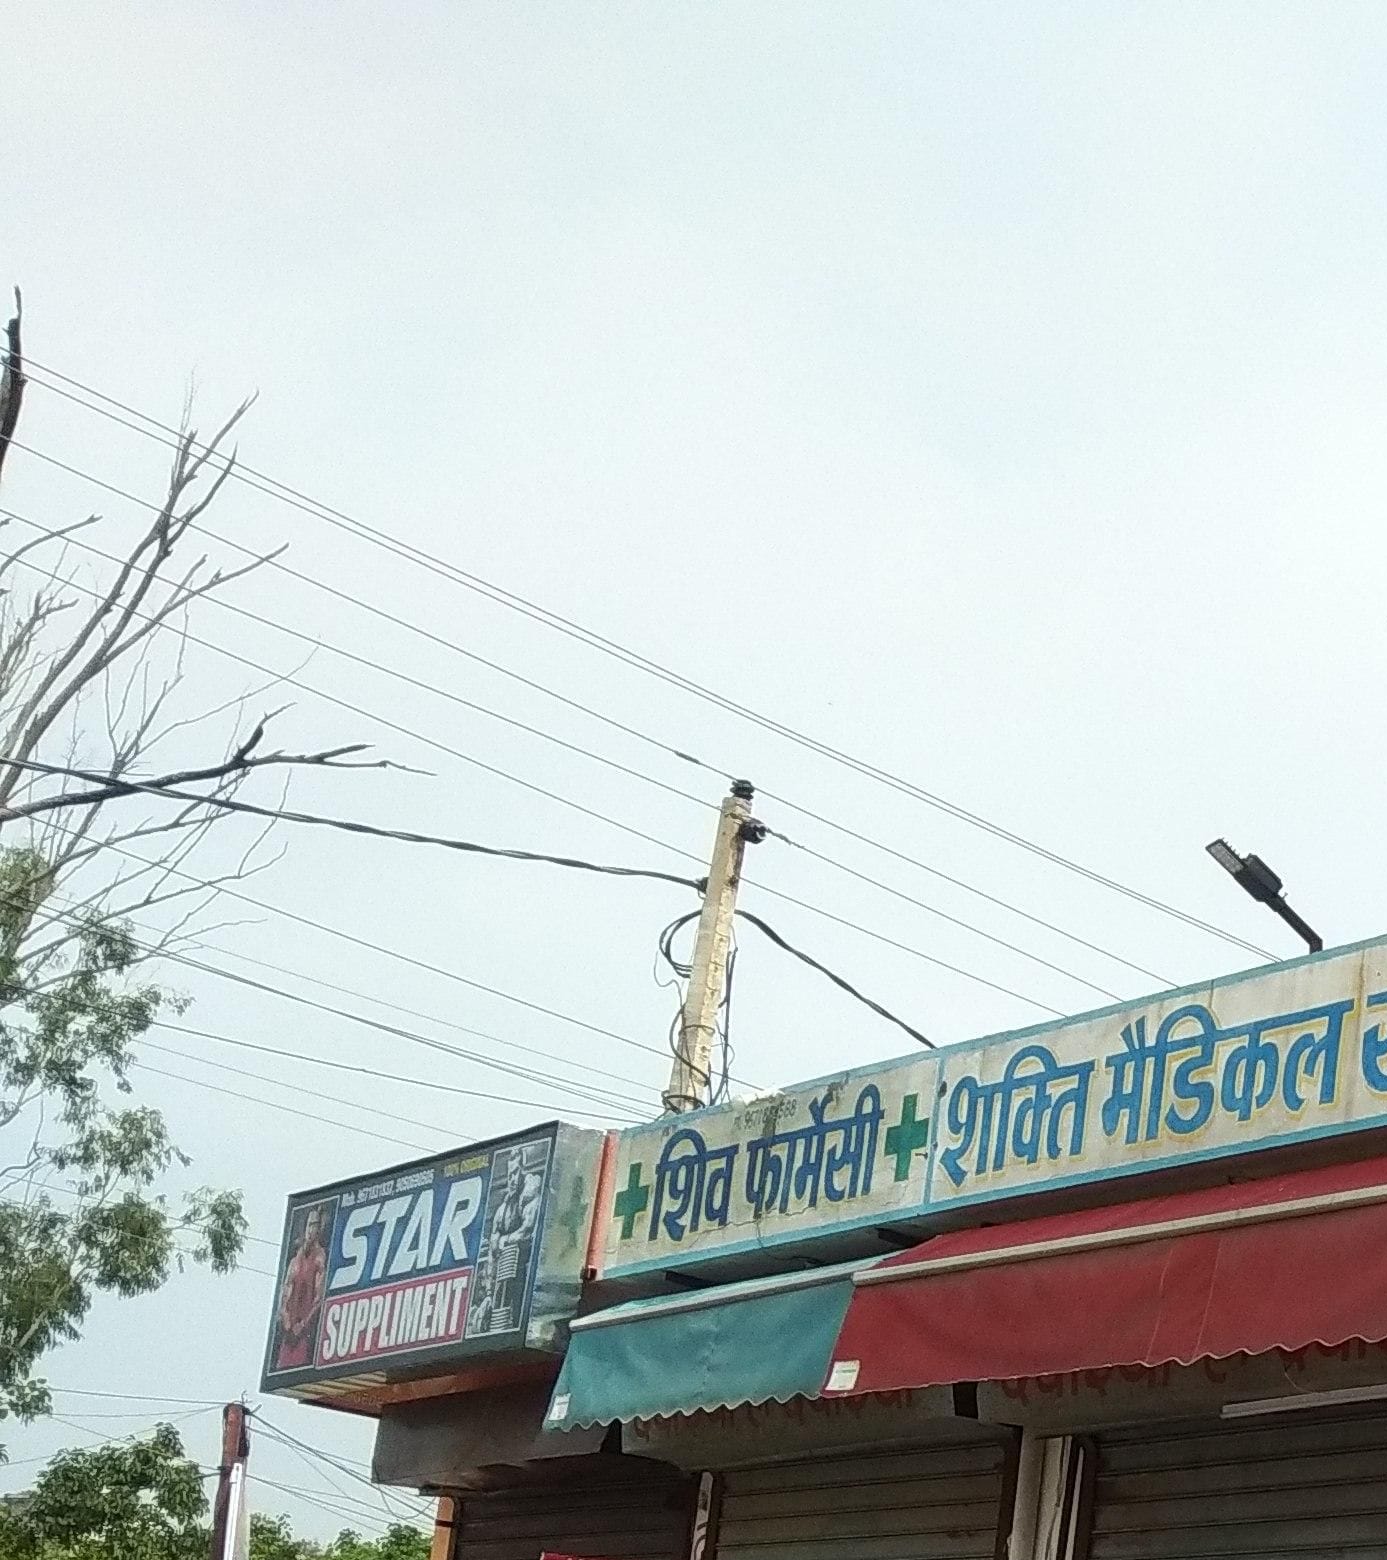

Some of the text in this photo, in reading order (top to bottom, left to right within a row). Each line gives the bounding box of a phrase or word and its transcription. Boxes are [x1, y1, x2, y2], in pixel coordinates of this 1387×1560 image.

[939, 1045, 1096, 1188] शक्ति
[1101, 1004, 1356, 1145] मैडिकल
[329, 1175, 482, 1290] STAR
[648, 1128, 740, 1242] शिव
[322, 1275, 469, 1360] SUPPLIMENT
